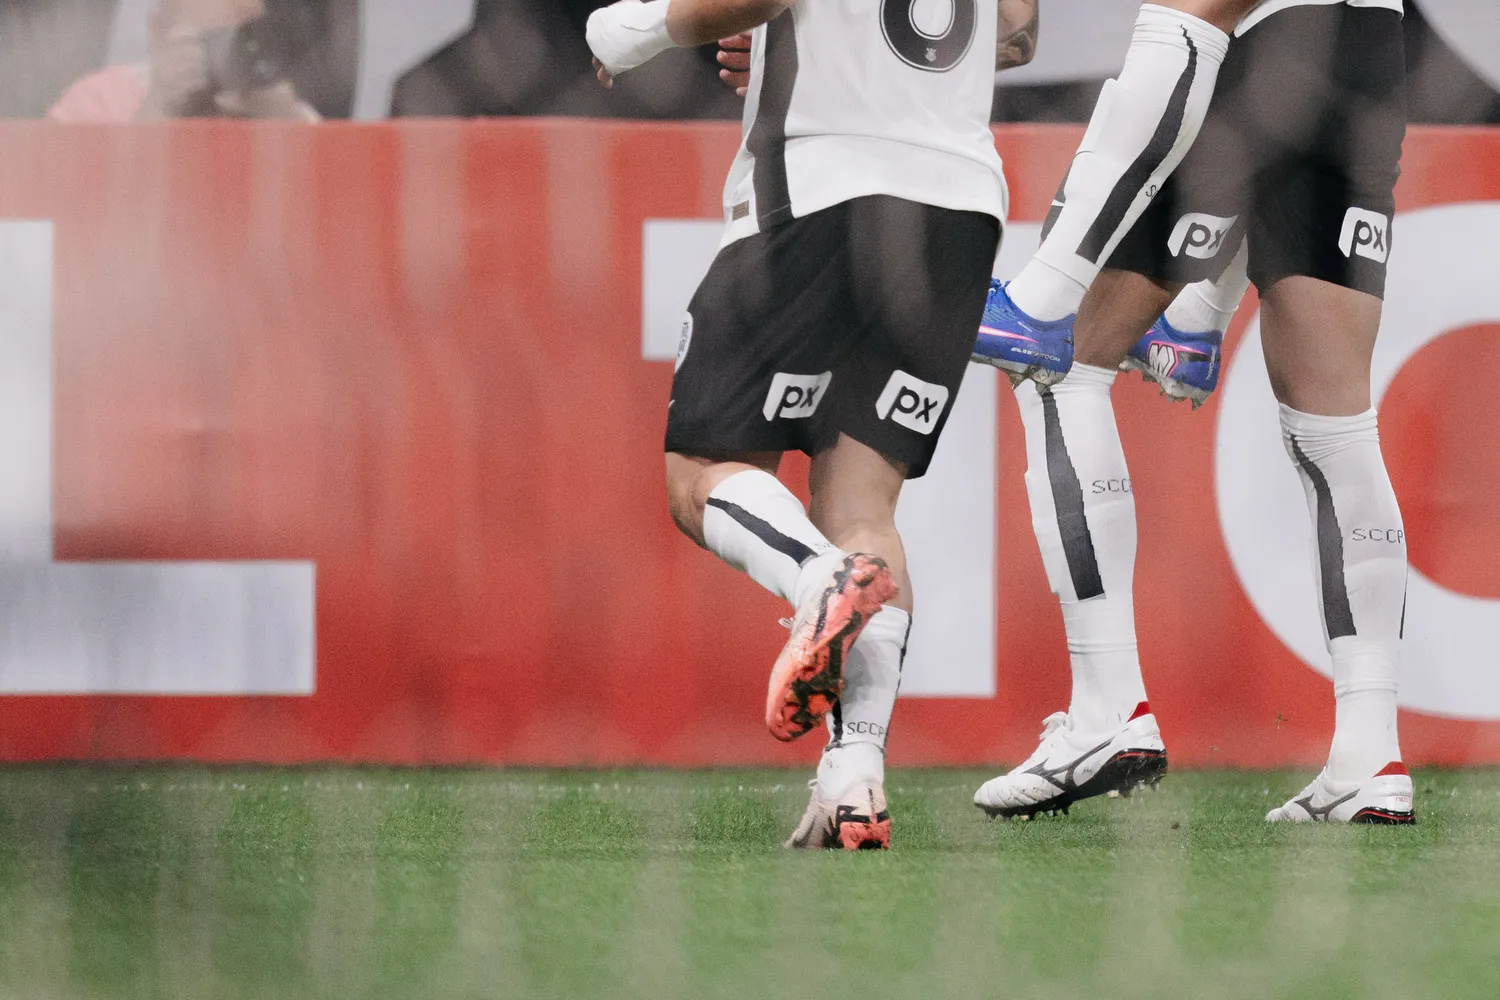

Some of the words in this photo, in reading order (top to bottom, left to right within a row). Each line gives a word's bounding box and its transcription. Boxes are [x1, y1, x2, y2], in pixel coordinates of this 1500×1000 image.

[1178, 222, 1231, 258] px
[1349, 219, 1385, 258] px
[773, 385, 820, 419] px
[885, 385, 938, 424] px
[1352, 527, 1404, 544] SCCP
